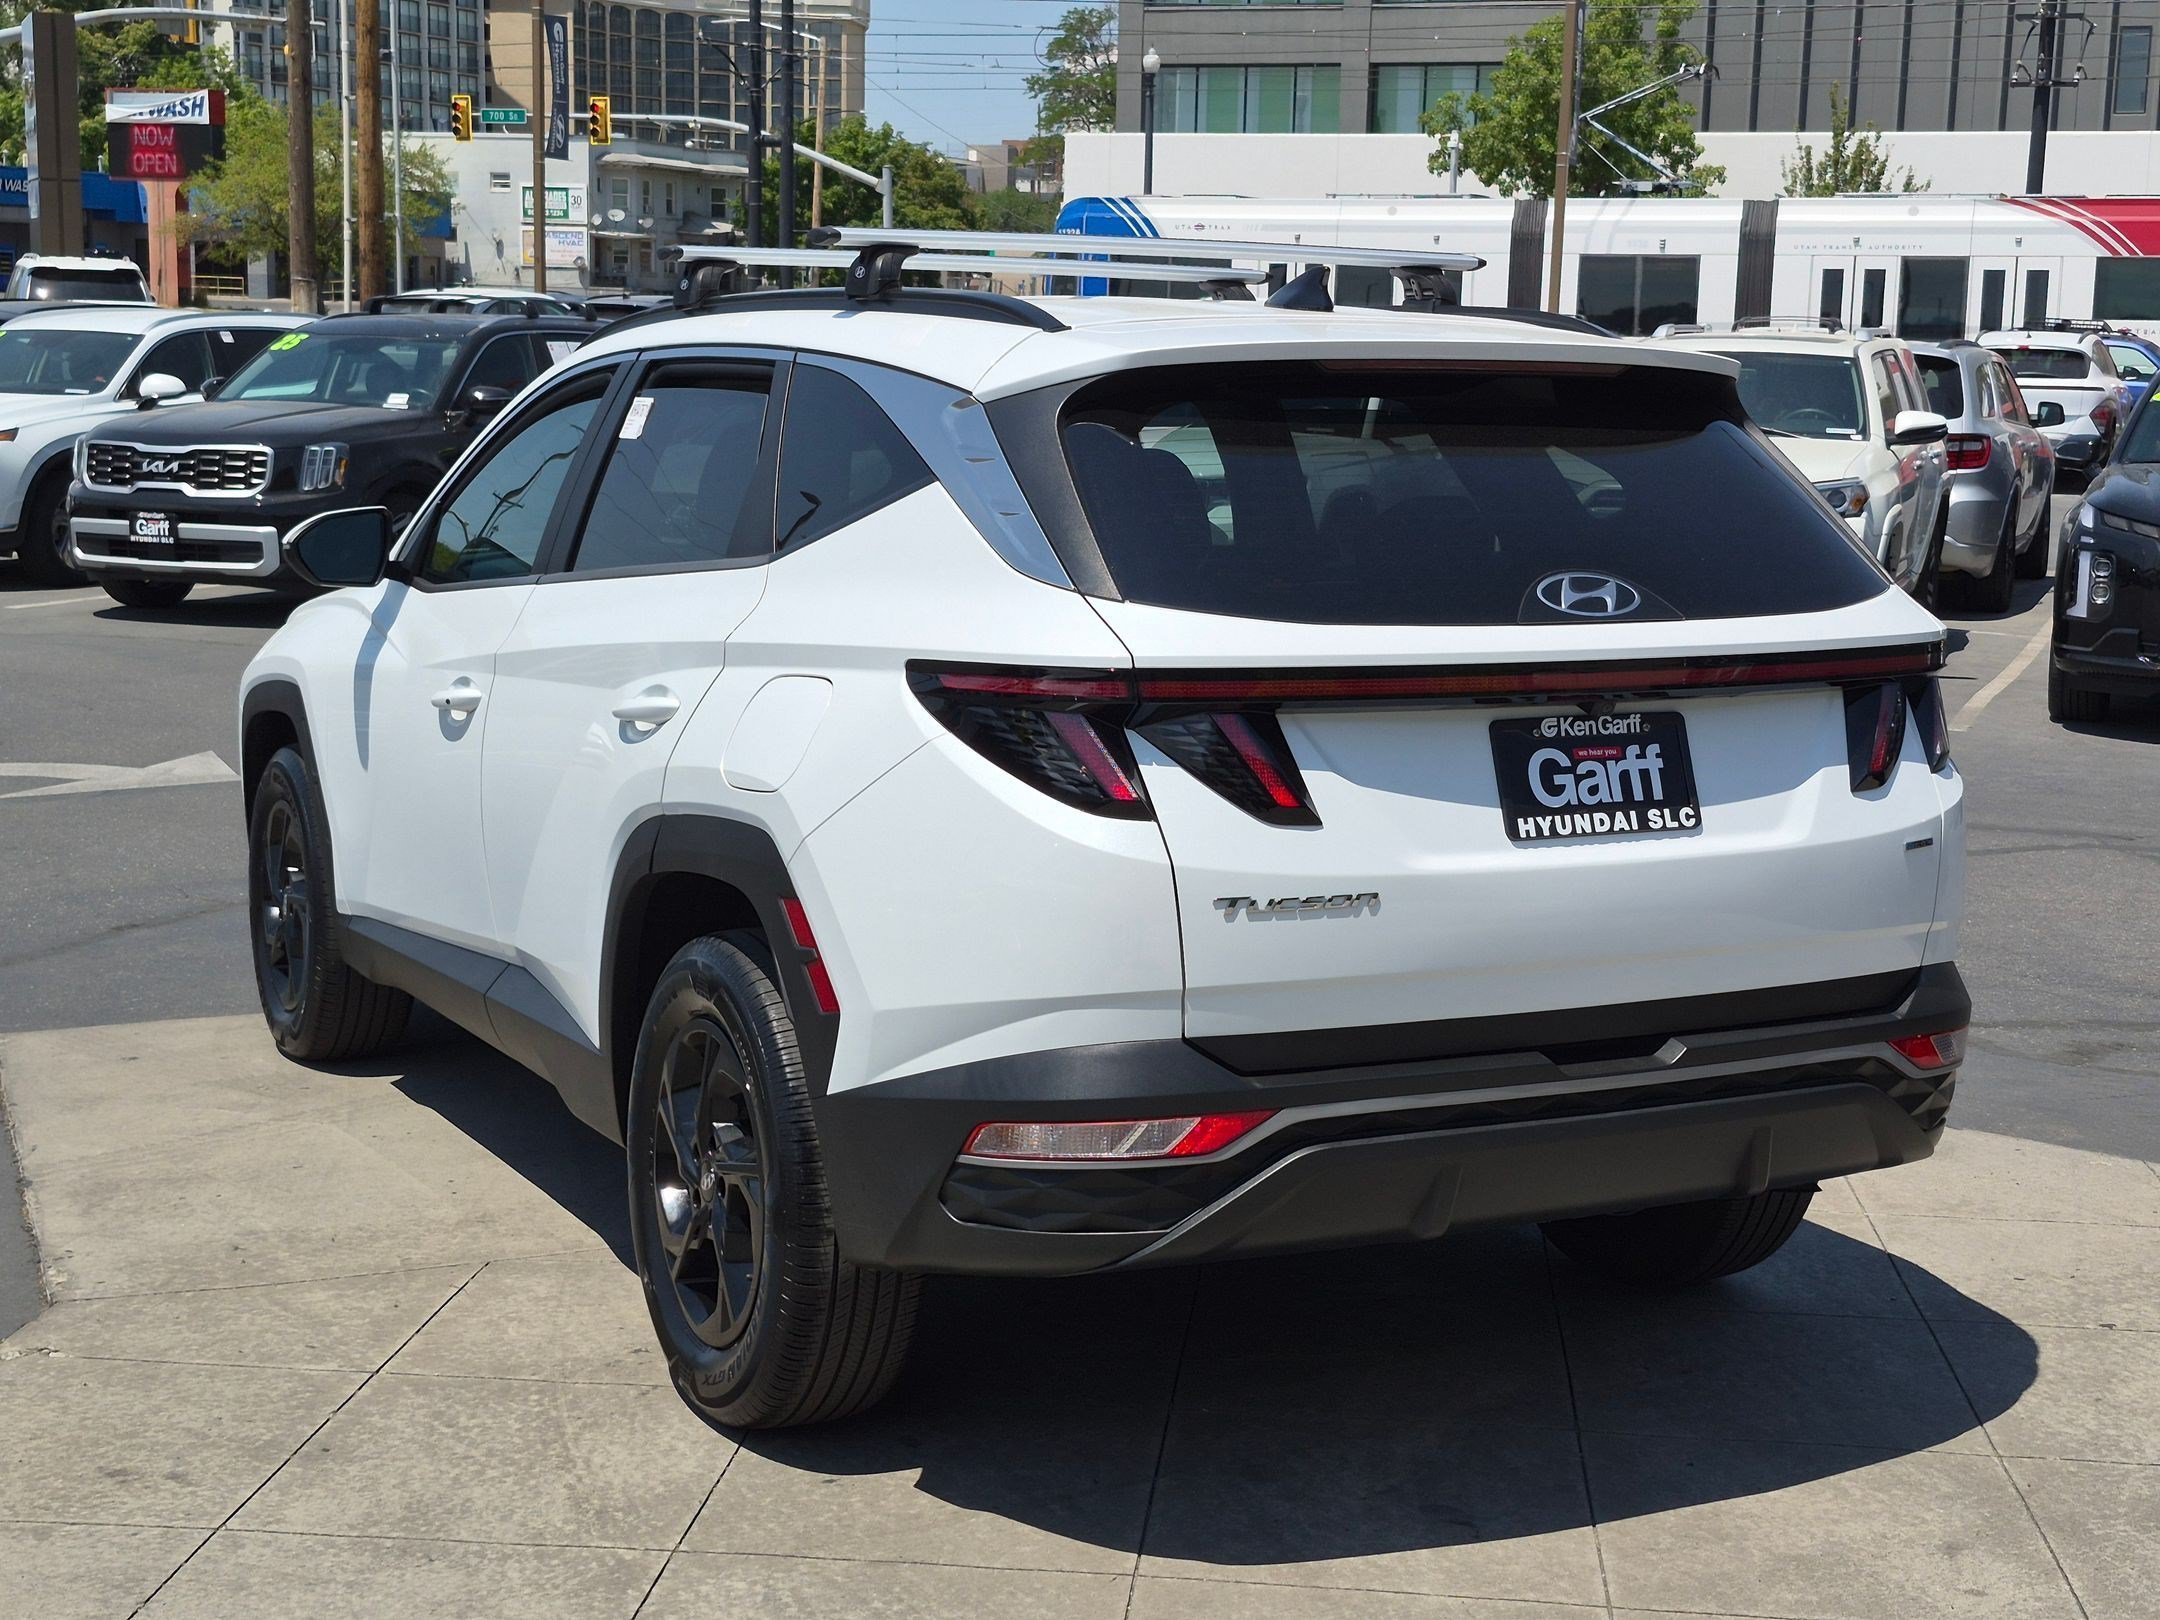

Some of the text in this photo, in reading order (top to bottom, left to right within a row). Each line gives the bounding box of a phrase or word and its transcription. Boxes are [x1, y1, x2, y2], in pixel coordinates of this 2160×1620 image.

[489, 111, 505, 121] 700
[134, 126, 174, 146] NOW
[133, 153, 177, 174] OPEN
[570, 195, 582, 206] 30
[136, 518, 170, 536] Garff
[130, 535, 160, 543] HYUNDAI
[1560, 713, 1642, 737] Ken Garff
[1528, 743, 1664, 808] Garff
[1517, 806, 1696, 838] HYUNDAI SLC
